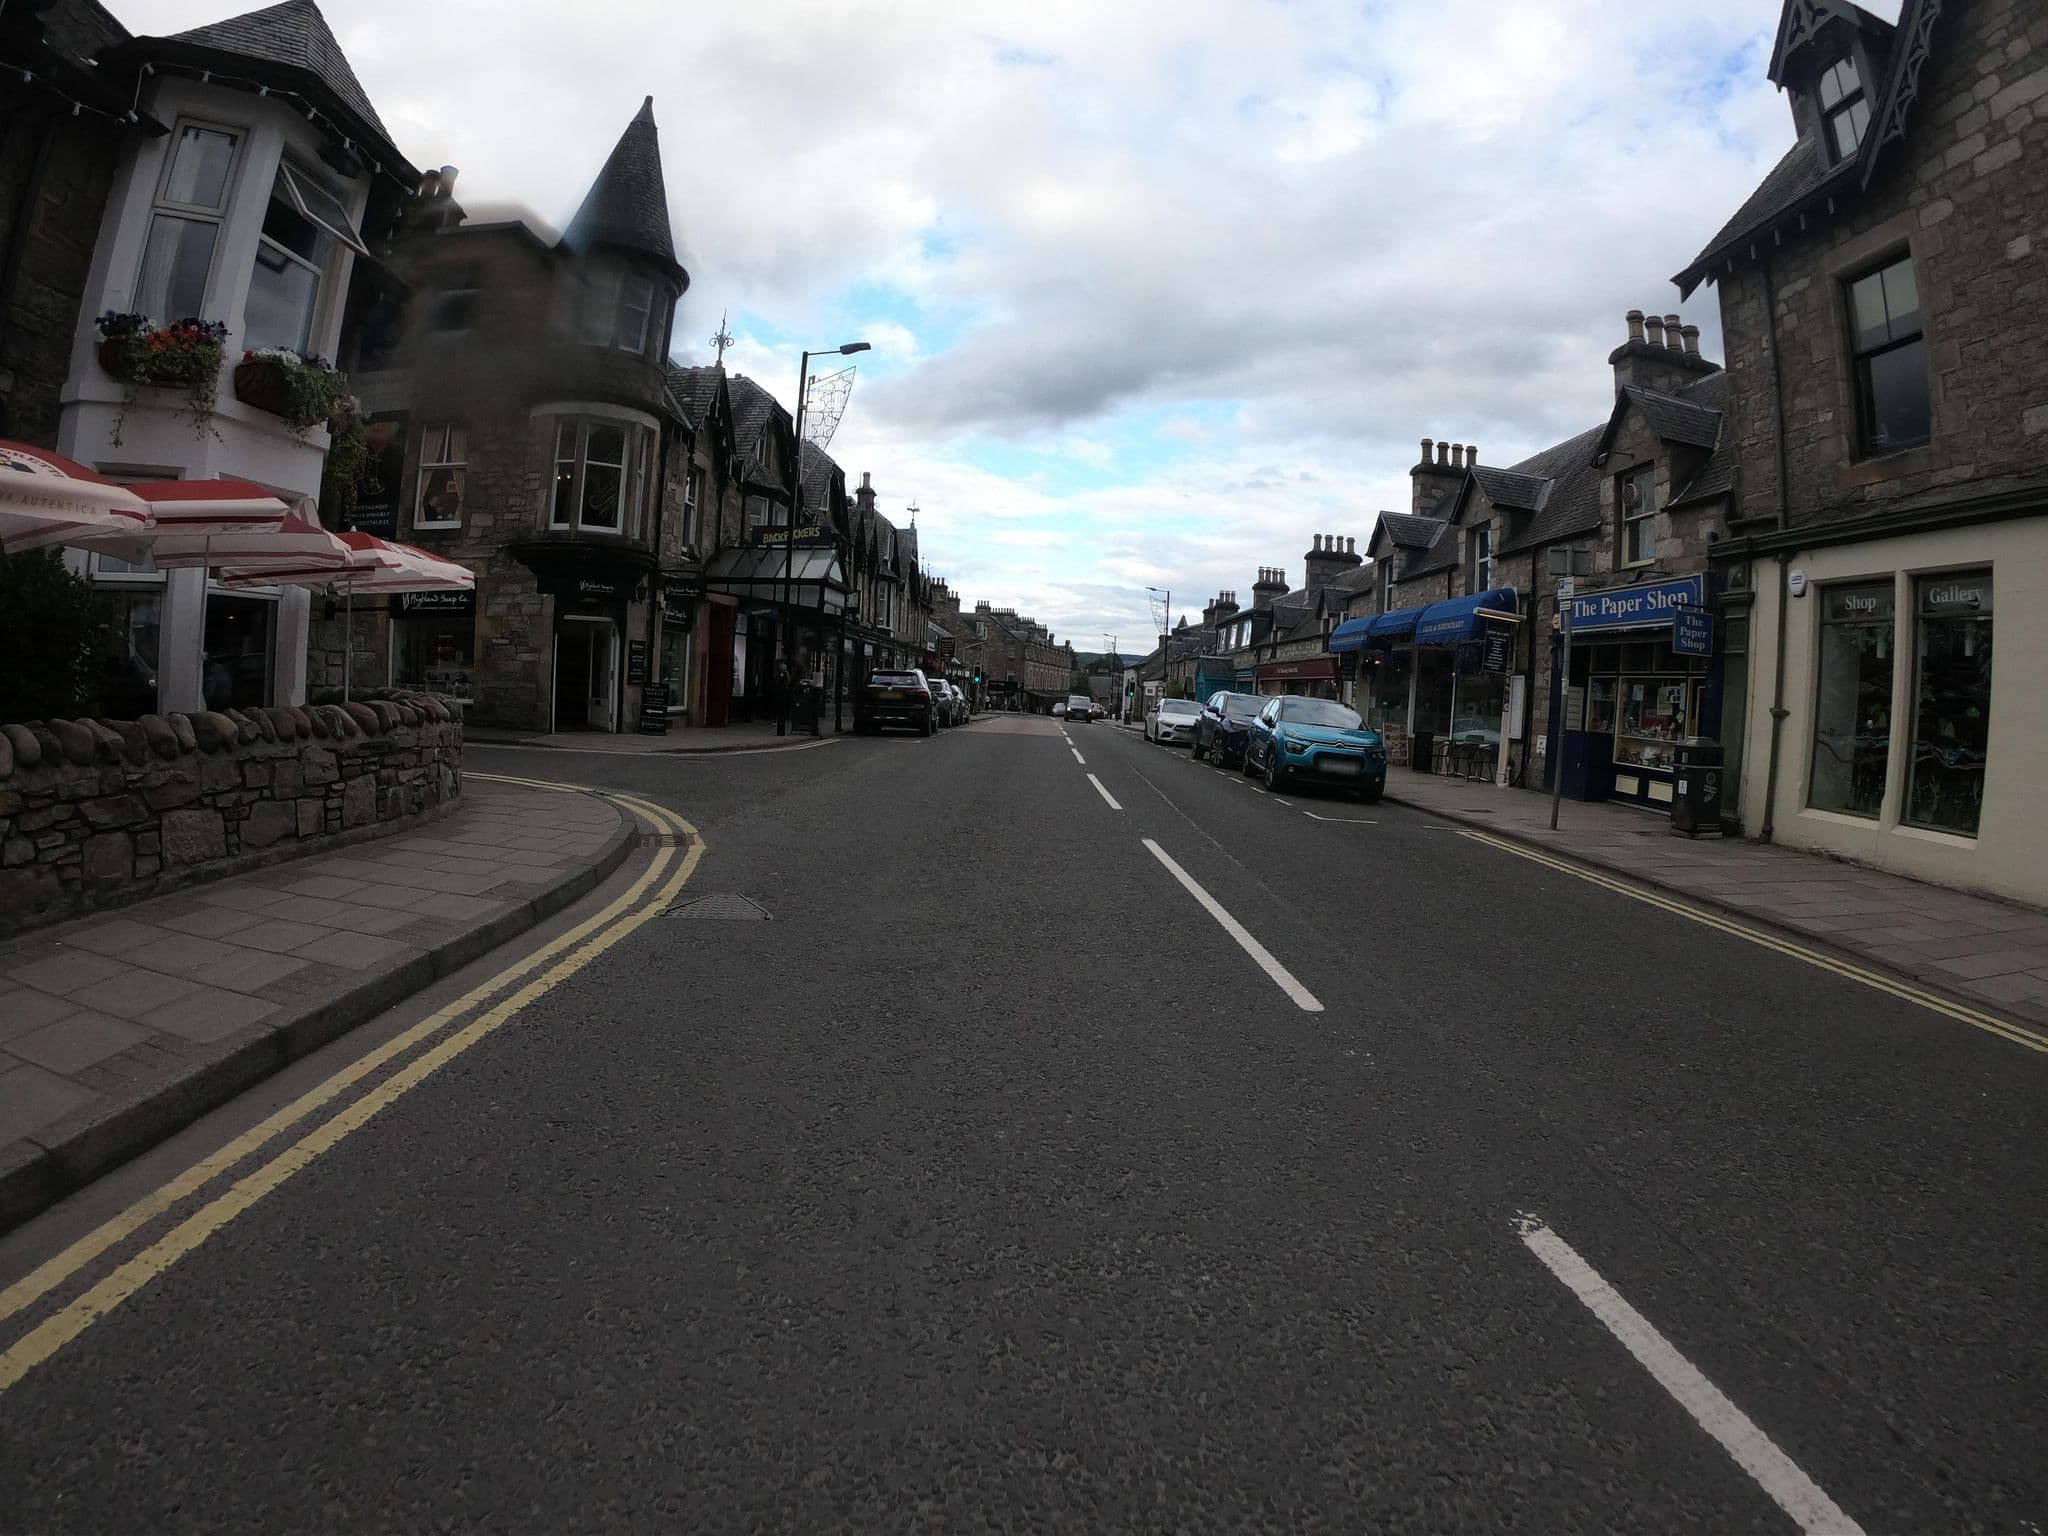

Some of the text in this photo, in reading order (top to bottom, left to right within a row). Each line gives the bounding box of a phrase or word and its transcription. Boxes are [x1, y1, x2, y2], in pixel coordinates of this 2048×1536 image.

[763, 526, 821, 544] BACKPCKERS
[1572, 590, 1688, 618] The Paper Shop
[1845, 594, 1876, 612] Shop
[1929, 585, 1984, 606] Gallery
[1684, 615, 1704, 627] The
[1680, 626, 1708, 640] Paper
[1681, 638, 1706, 652] Shop
